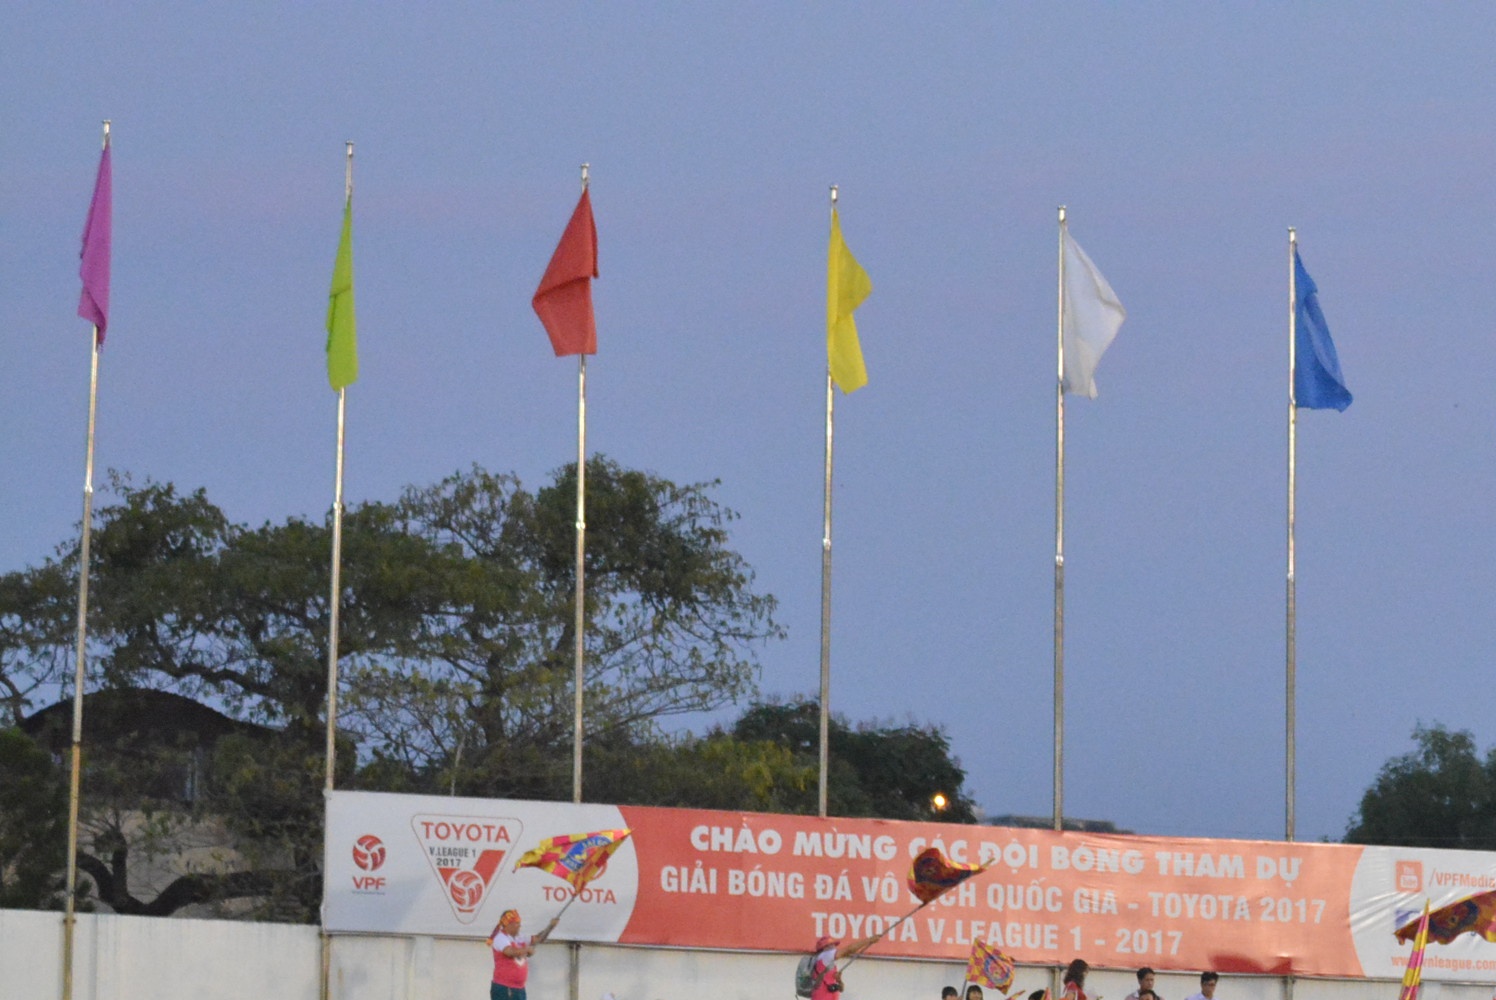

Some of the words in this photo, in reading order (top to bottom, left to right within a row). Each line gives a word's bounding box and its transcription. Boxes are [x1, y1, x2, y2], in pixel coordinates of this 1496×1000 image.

[420, 821, 511, 844] TOYOTA
[429, 846, 469, 858] V.LEAGUE
[471, 849, 477, 859] 1
[436, 858, 463, 868] 2017
[690, 822, 783, 855] CHÀO
[792, 827, 898, 861] MỪNG
[977, 839, 1039, 874] ĐỘI
[1051, 841, 1145, 874] BÓNG
[1155, 851, 1245, 878] THAM
[1256, 855, 1303, 888] DỰ
[352, 876, 387, 890] VPF
[660, 860, 717, 895] GIẢI
[728, 864, 805, 899] BÓNG
[813, 869, 853, 902] ĐÁ
[861, 871, 899, 904] VÔ
[986, 877, 1063, 912] QUỐC
[1073, 888, 1119, 915] GIA
[1148, 892, 1251, 921] TOYOTA
[1259, 897, 1327, 924] 2017
[811, 912, 919, 943] TOYOTA
[927, 919, 1059, 950] V.LEAGUE
[1069, 926, 1082, 951] 1
[1115, 928, 1184, 956] 2017
